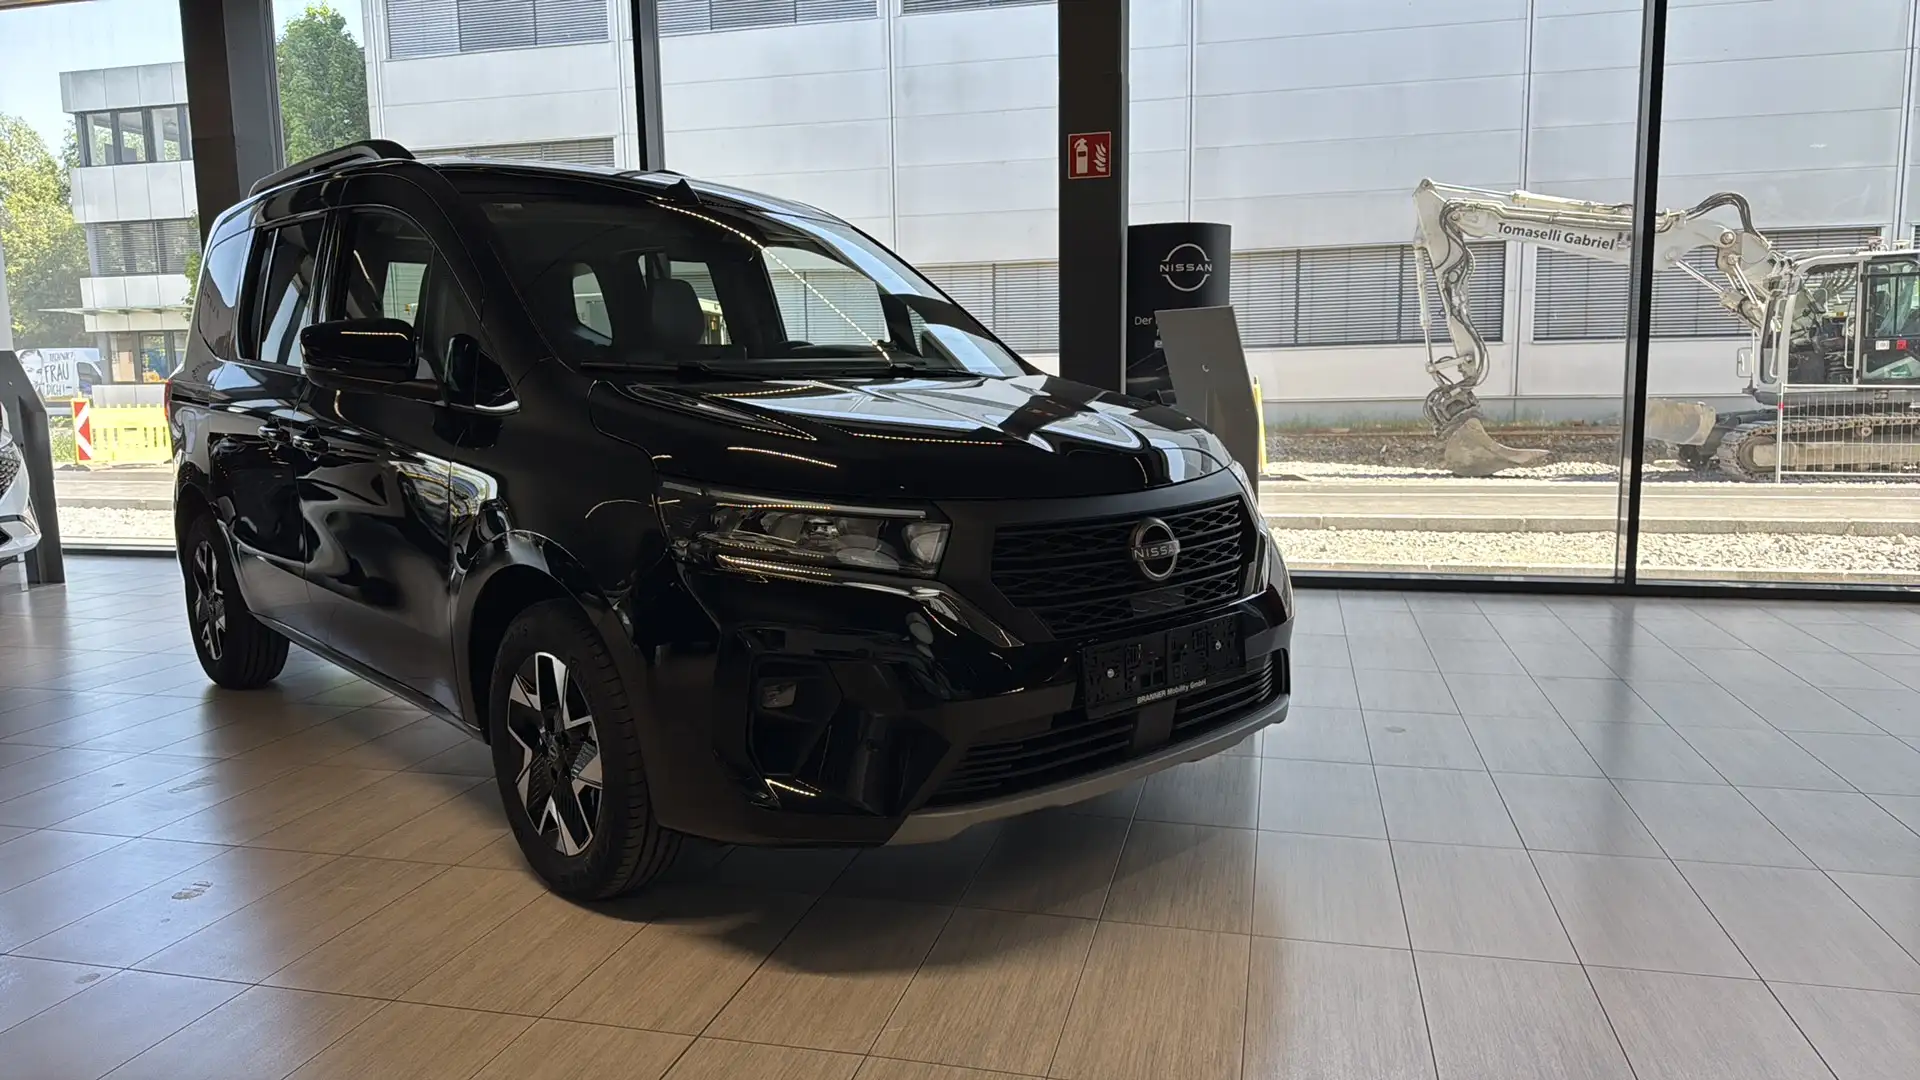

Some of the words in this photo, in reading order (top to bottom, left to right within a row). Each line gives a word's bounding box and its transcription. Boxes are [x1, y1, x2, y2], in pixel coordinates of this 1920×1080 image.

[1498, 222, 1561, 242] Tomaselli
[1564, 232, 1616, 250] Gabriel
[1159, 263, 1212, 272] NISSAN
[1134, 316, 1153, 325] Der
[44, 362, 70, 383] FRAU
[1134, 543, 1178, 558] NISSA
